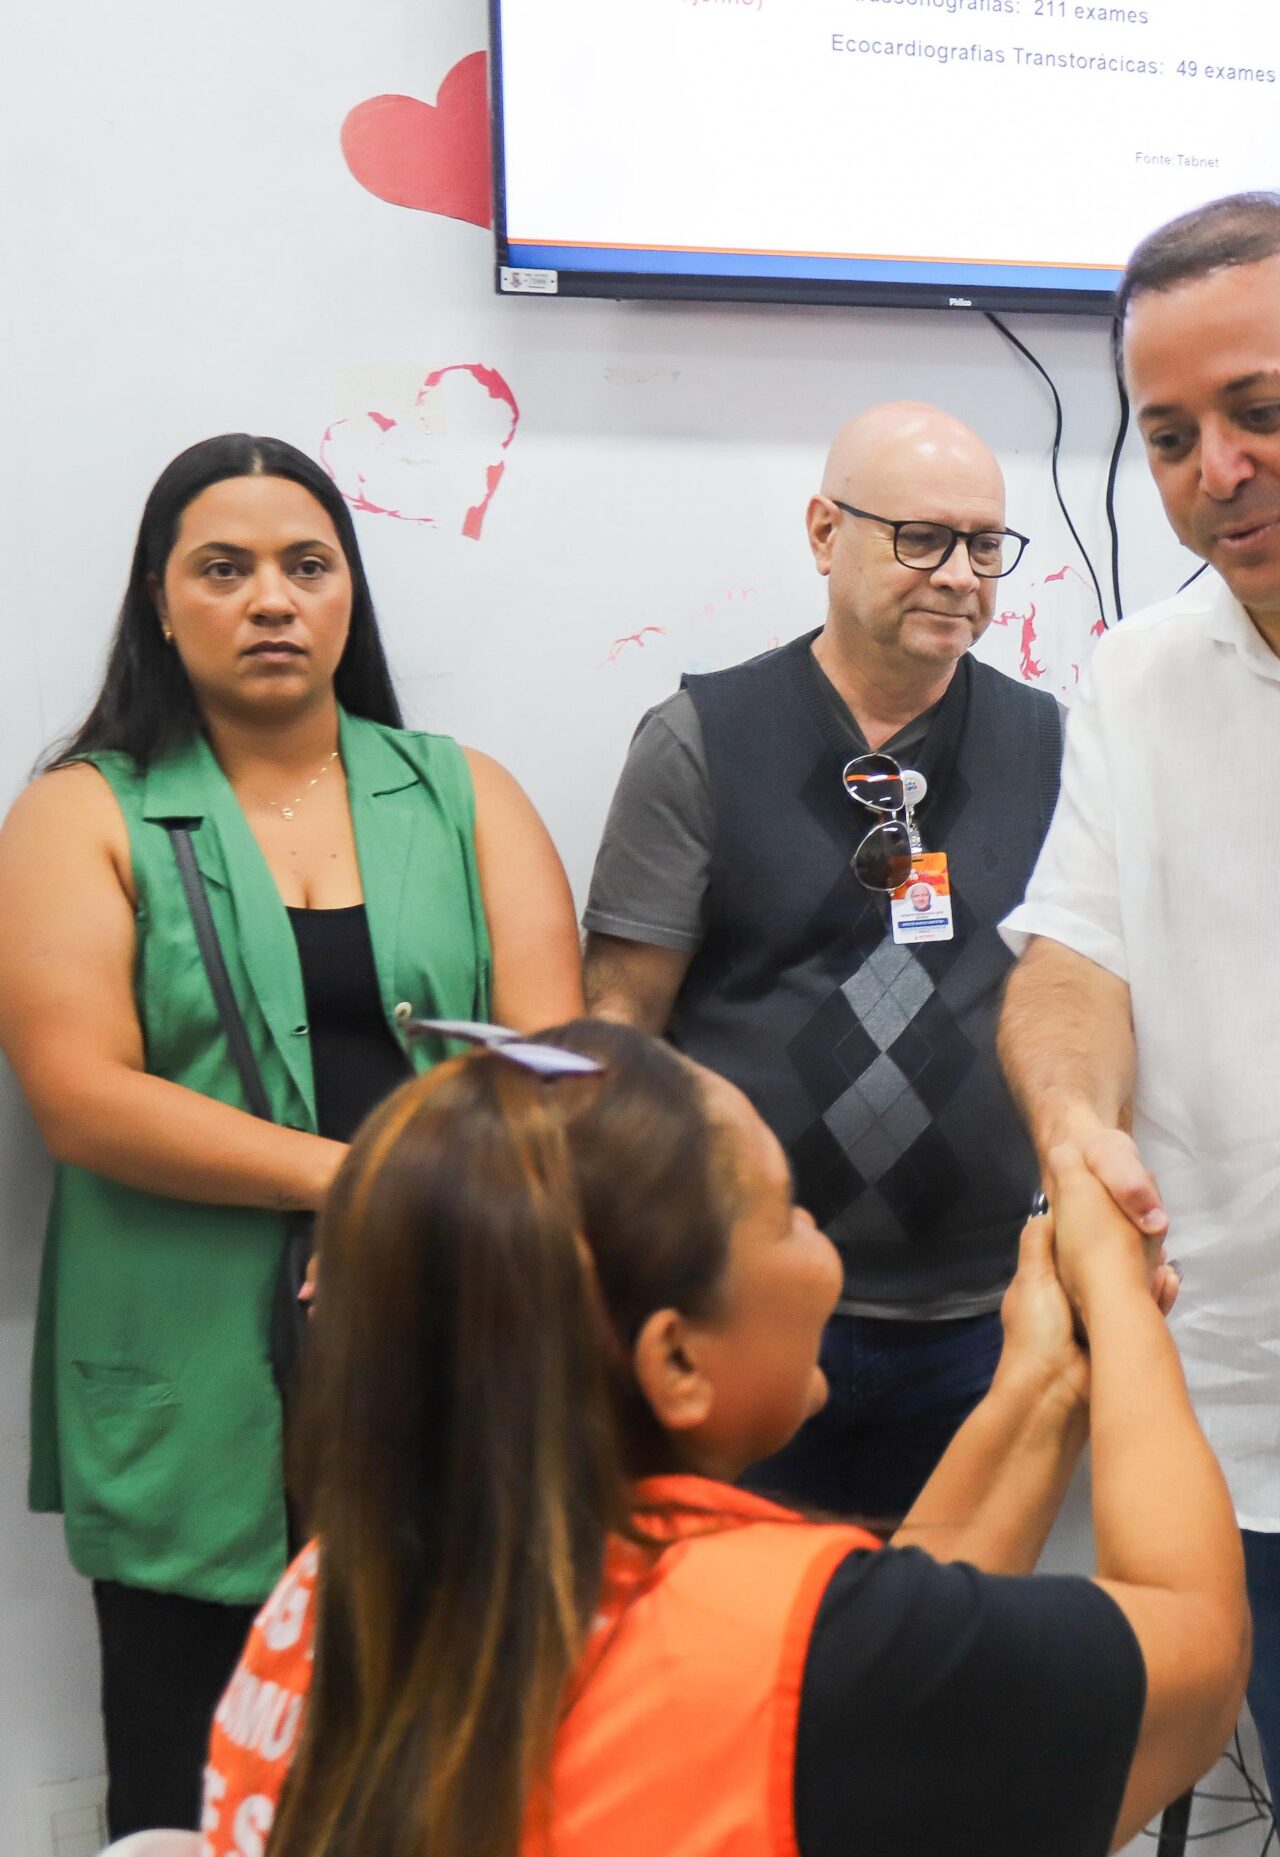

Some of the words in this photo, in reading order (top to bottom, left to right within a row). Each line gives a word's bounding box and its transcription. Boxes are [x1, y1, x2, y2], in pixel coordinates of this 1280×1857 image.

[1034, 0, 1066, 18] 211
[1074, 5, 1149, 24] exames
[831, 34, 1005, 63] Ecocardiografias
[1013, 47, 1164, 75] Transtorácicas:
[1176, 60, 1198, 77] 49
[1204, 64, 1276, 83] exames
